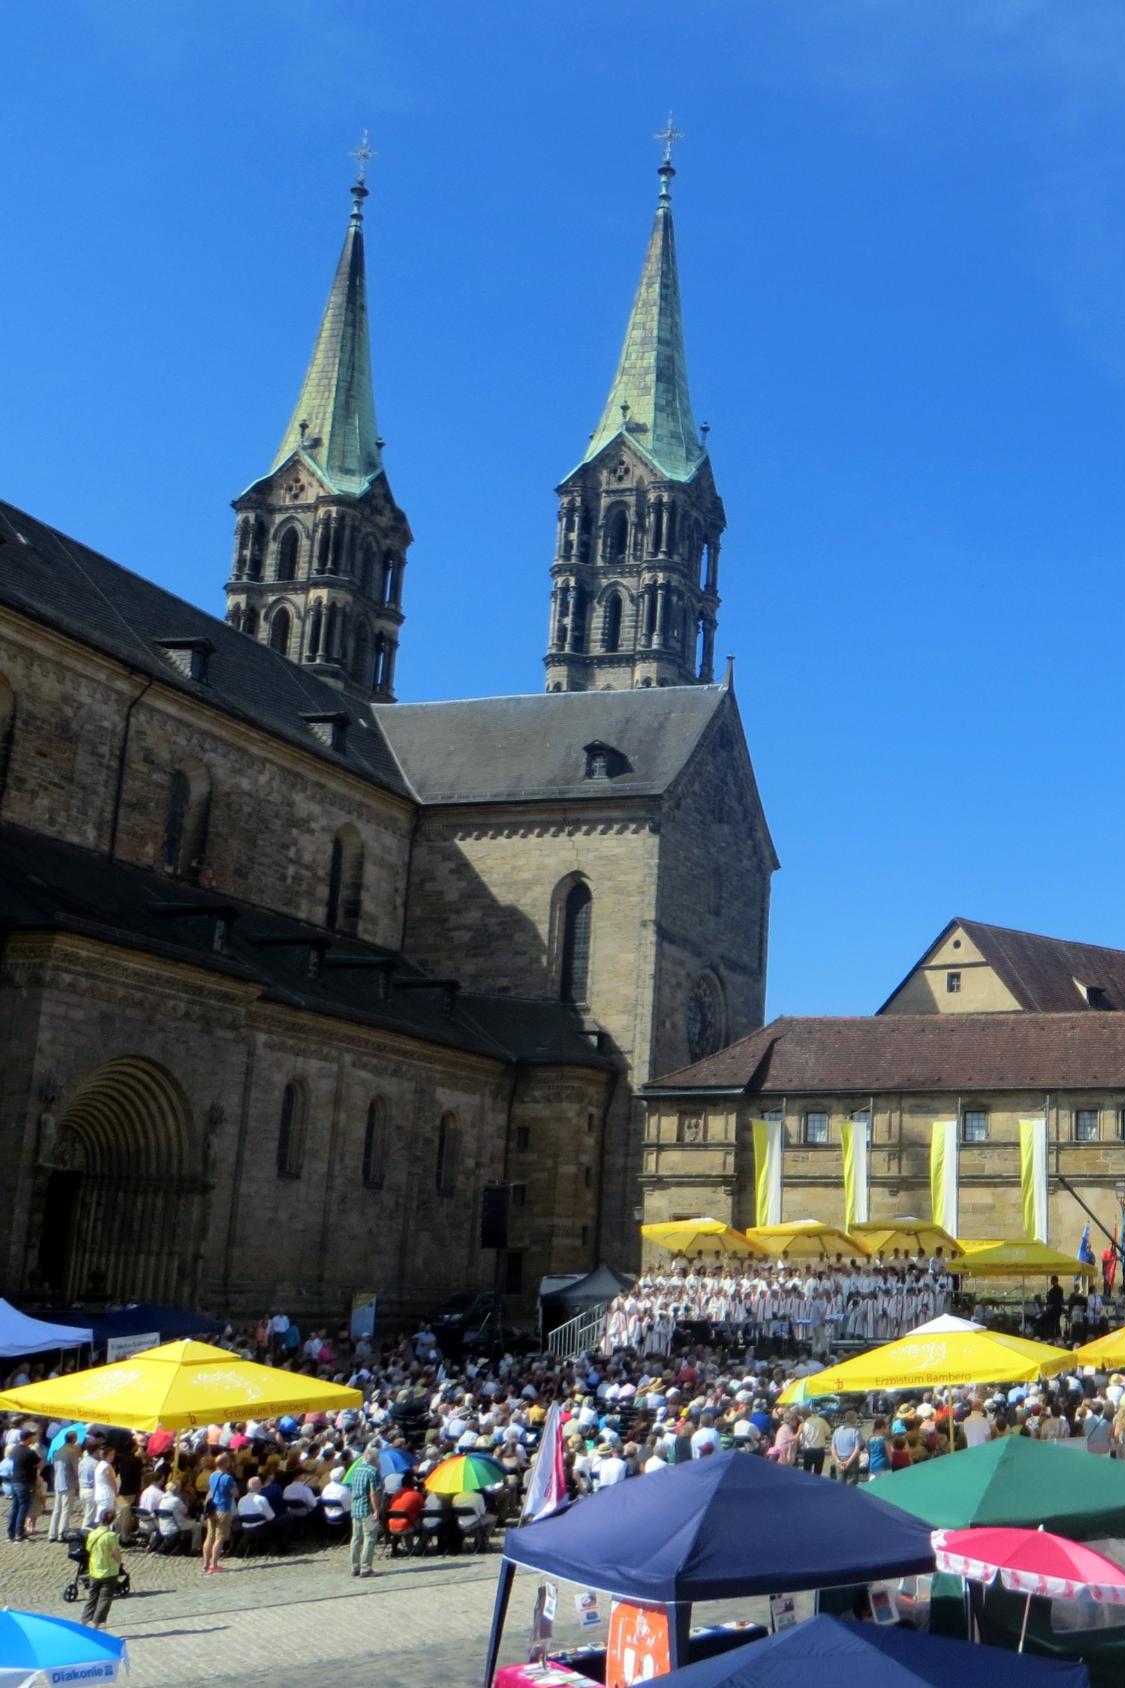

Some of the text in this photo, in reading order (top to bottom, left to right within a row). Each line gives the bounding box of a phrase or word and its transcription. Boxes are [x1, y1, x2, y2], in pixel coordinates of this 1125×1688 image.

[875, 1373, 972, 1386] Erzbistum Bamberg
[77, 1407, 113, 1423] Bamberg
[223, 1402, 310, 1419] Erzbistum Bamberg
[52, 1666, 103, 1684] Diakonie
